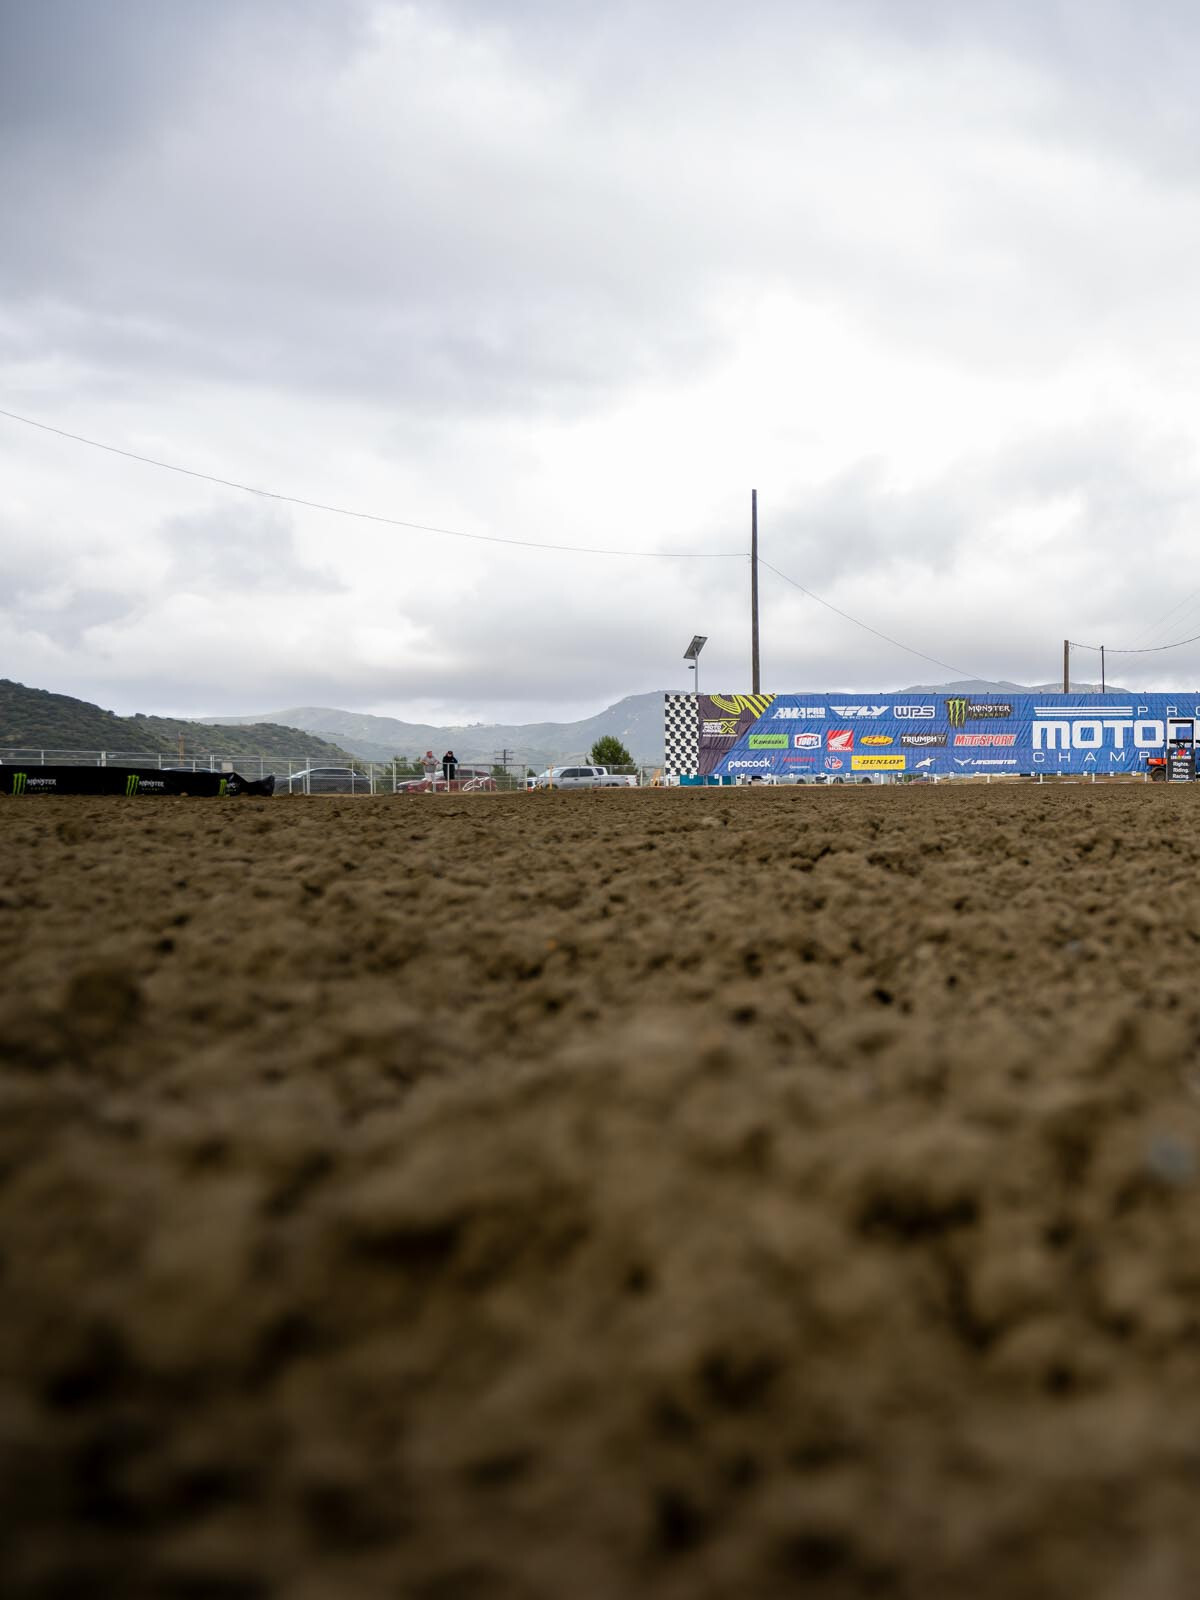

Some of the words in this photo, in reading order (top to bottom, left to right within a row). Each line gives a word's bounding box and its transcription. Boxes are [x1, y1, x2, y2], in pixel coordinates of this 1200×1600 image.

[771, 707, 806, 719] AMA
[895, 706, 935, 718] WPS
[968, 705, 1011, 713] MONSTER
[798, 737, 818, 746] 100%
[902, 736, 938, 745] TRIUMPH
[728, 758, 771, 771] peacock
[27, 778, 57, 786] MONSTER
